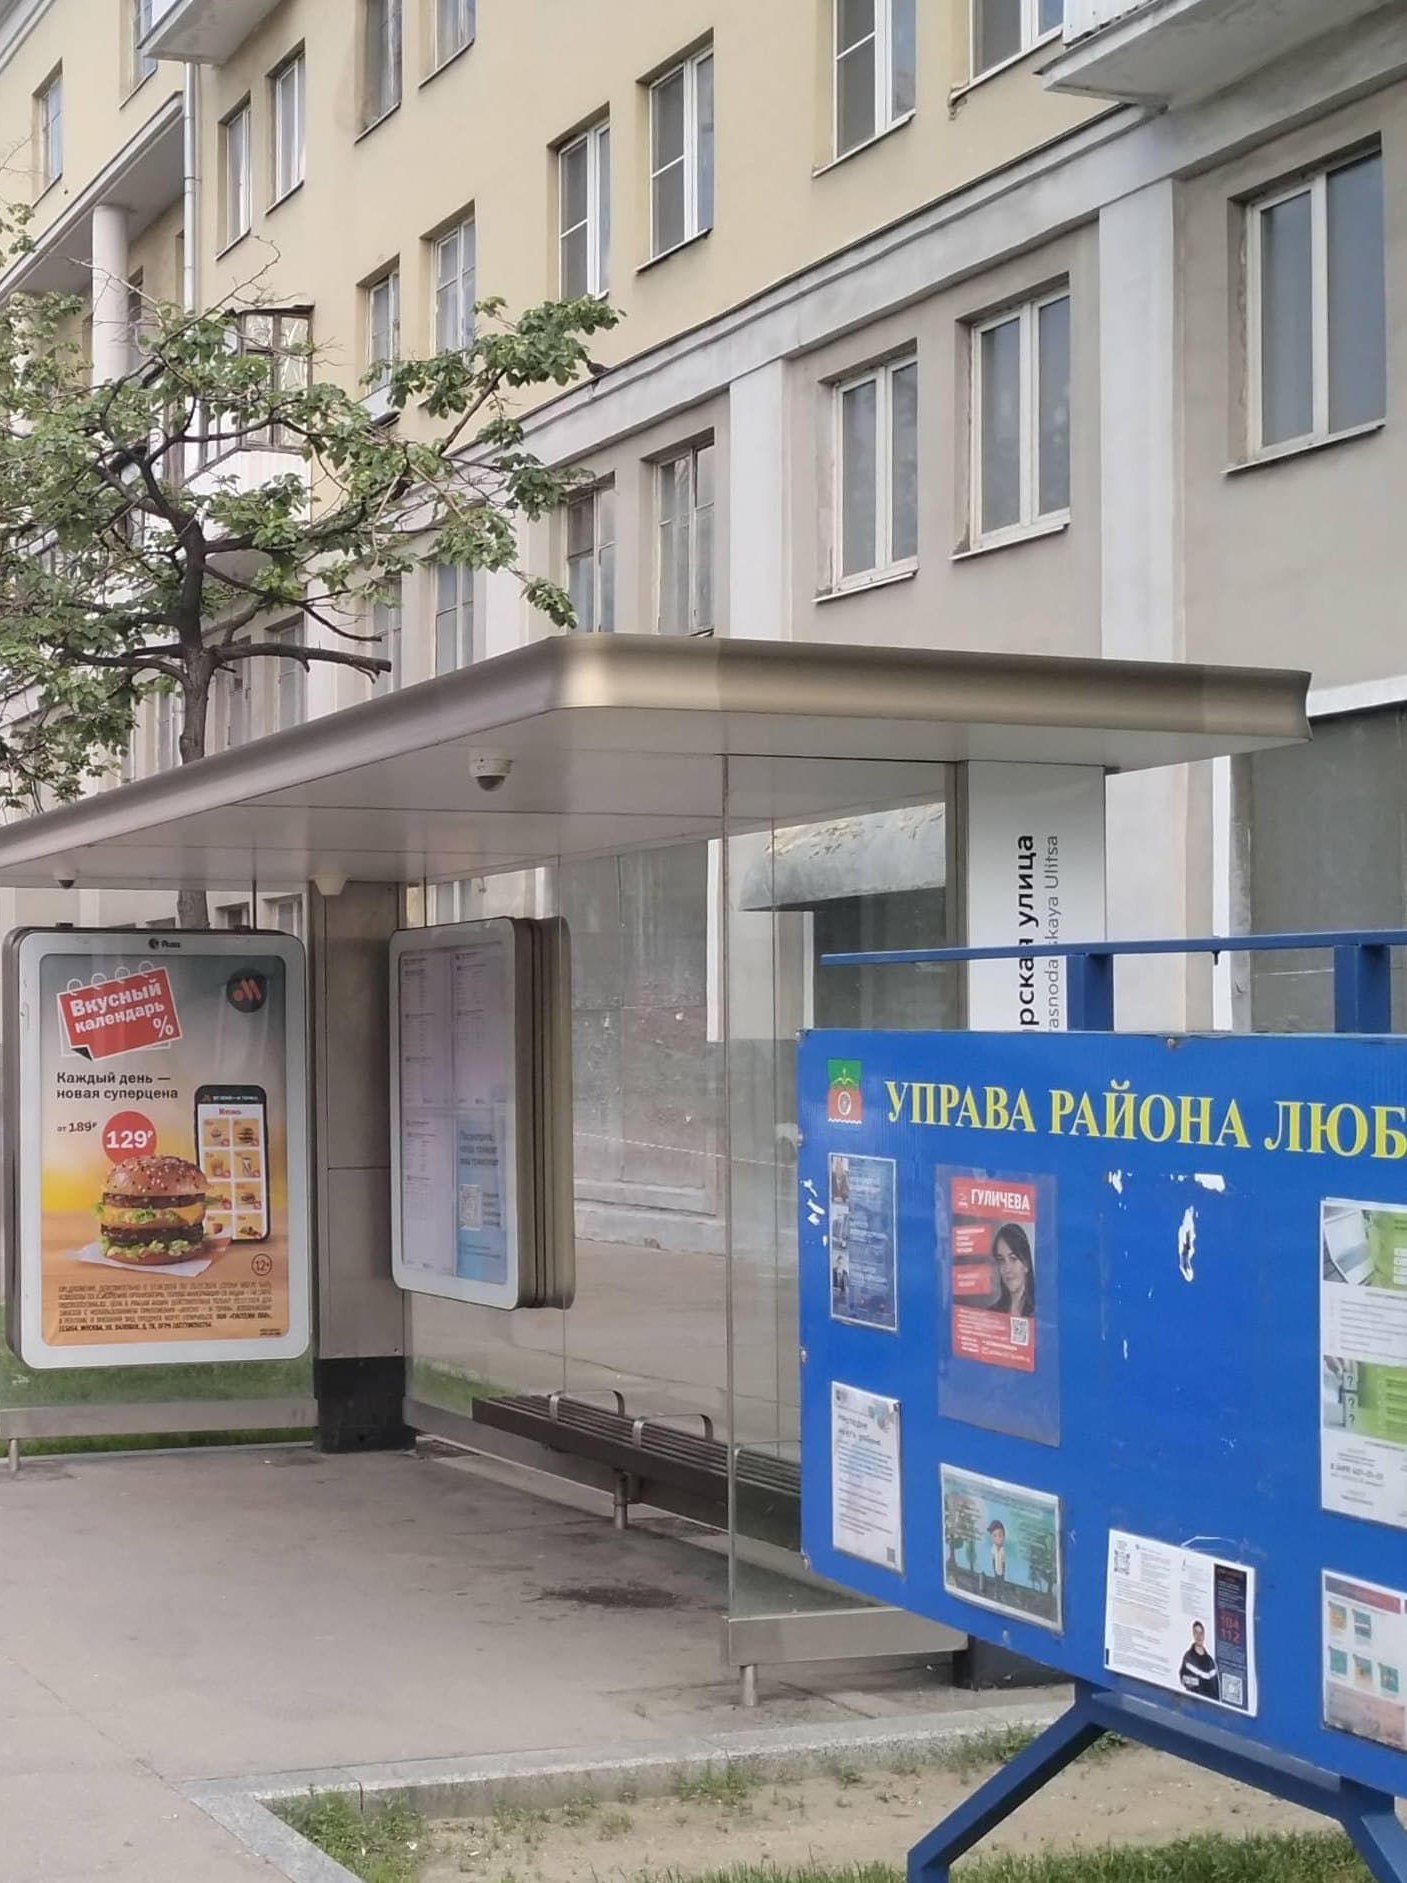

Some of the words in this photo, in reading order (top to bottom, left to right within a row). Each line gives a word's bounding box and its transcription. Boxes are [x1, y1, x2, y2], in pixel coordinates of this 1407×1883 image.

[1044, 835, 1059, 889] Ulitsa
[1018, 835, 1039, 927] улица
[70, 979, 162, 1017] Вкусный
[75, 1001, 165, 1034] календарь
[153, 1015, 174, 1039] %
[57, 1070, 116, 1086] Каждый
[119, 1074, 153, 1085] день
[57, 1089, 100, 1100] новая
[104, 1089, 178, 1102] суперцена
[884, 1081, 1037, 1132] УПРАВА
[1048, 1078, 1250, 1149] РАЙОНА
[1264, 1100, 1407, 1159] ЛЮБ
[971, 1188, 1030, 1211] ГУЛИЧЕВА
